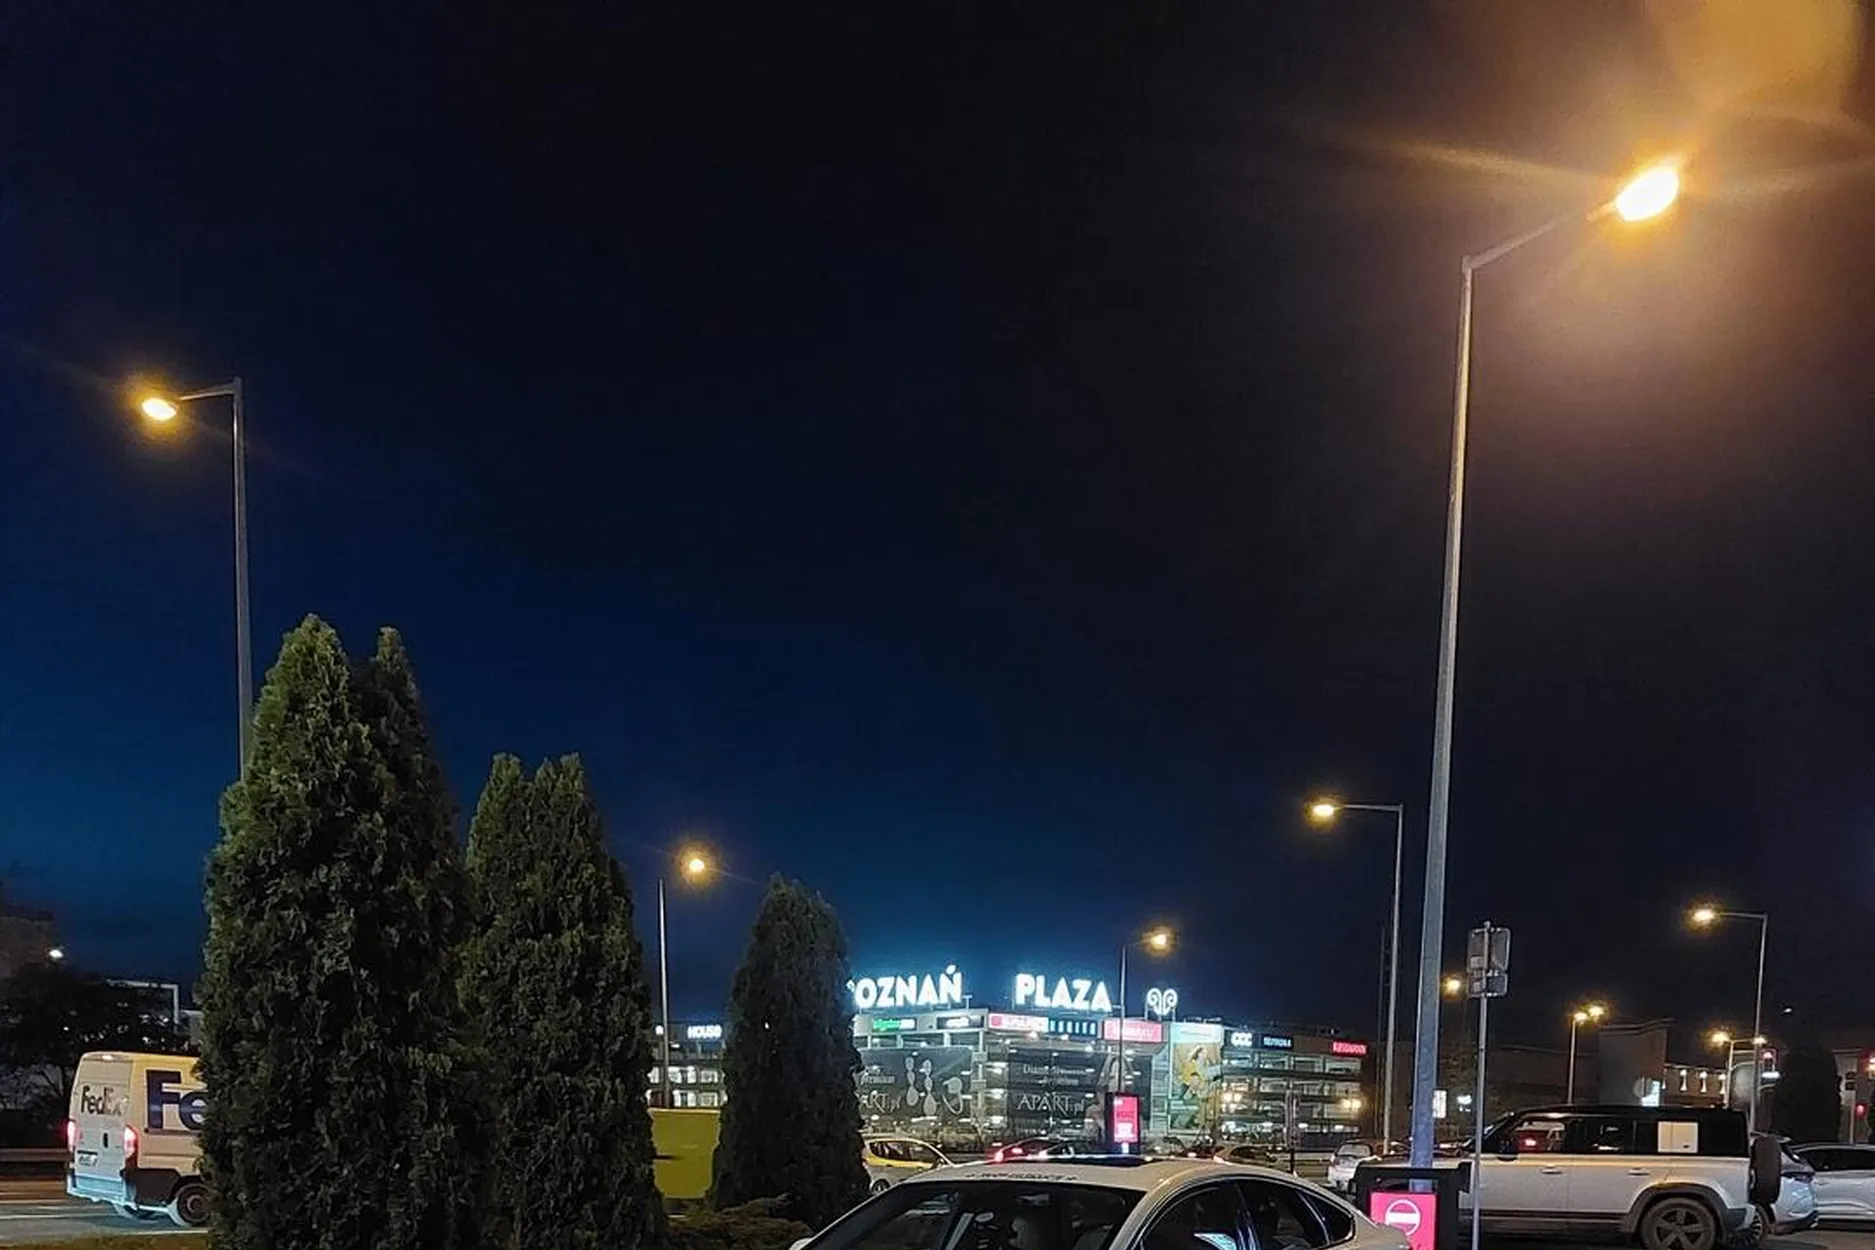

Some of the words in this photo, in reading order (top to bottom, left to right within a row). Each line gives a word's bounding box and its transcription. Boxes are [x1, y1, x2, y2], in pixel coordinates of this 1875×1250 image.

[847, 964, 962, 1008] OZNAŃ
[1015, 973, 1112, 1012] PLAZA
[81, 1085, 122, 1116] FedEx
[146, 1070, 207, 1131] Fe
[1017, 1092, 1084, 1116] APART.pl
